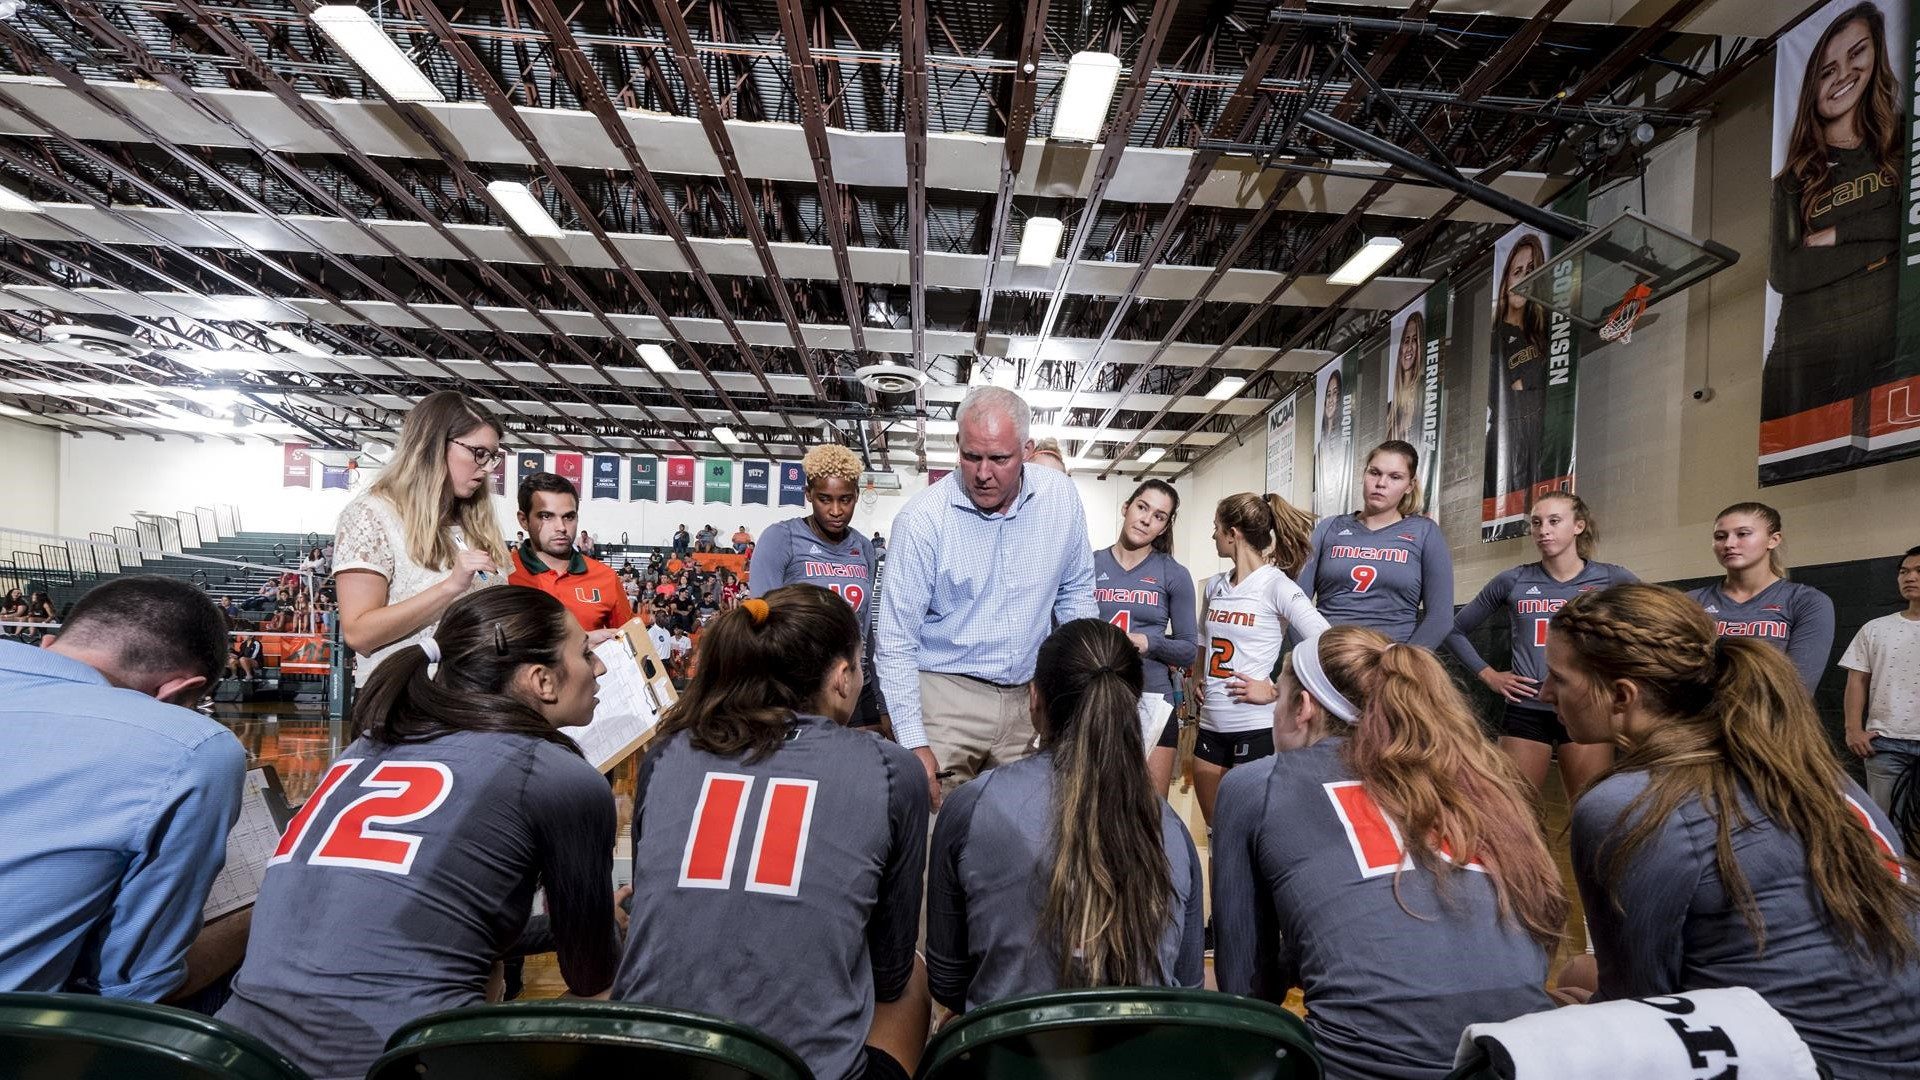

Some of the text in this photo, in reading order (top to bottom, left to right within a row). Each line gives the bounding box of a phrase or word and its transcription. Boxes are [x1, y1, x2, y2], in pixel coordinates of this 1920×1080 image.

[1549, 259, 1573, 386] SORENSEN
[1270, 399, 1294, 433] NCAA
[1423, 339, 1439, 451] HERNANDEZ
[575, 587, 601, 603] U
[1350, 565, 1377, 593] 9
[1208, 636, 1235, 679] 2
[266, 758, 453, 876] 12
[677, 771, 819, 897] 11
